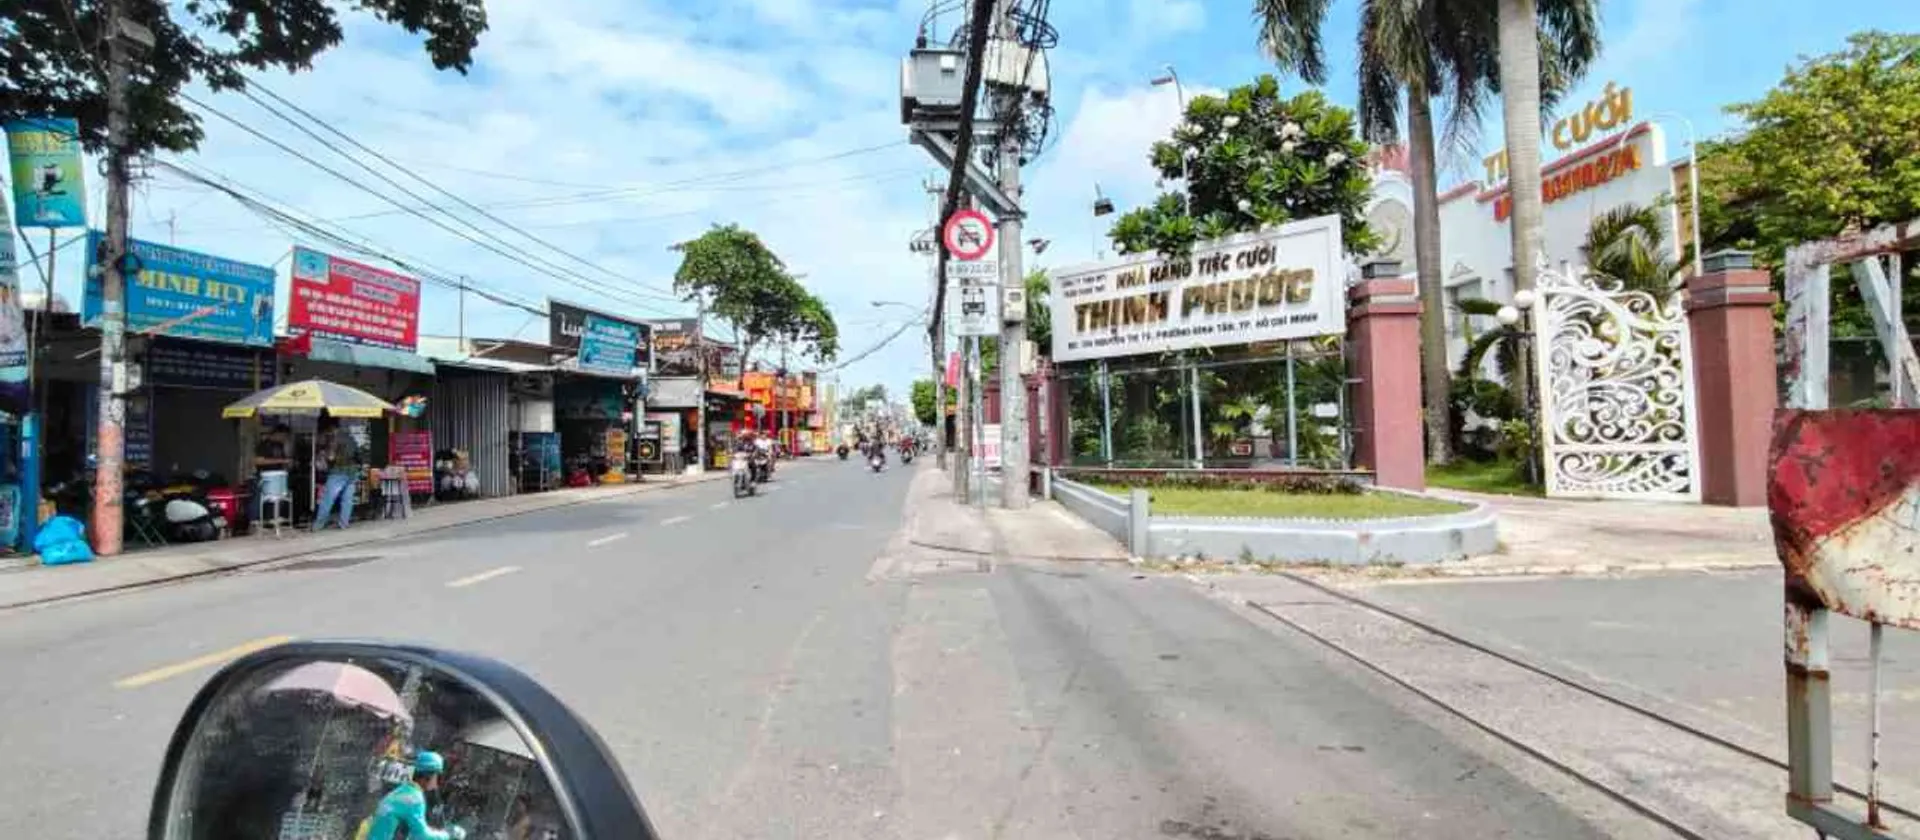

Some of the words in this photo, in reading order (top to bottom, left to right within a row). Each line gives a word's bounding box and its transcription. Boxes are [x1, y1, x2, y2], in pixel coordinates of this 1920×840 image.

[137, 268, 200, 296] MINH
[204, 278, 248, 304] HUY
[1116, 263, 1146, 289] NHÀ
[1149, 257, 1192, 283] HÀNG
[1198, 252, 1232, 277] TIỆC
[1236, 241, 1277, 270] CƯỚI
[1074, 289, 1169, 335] THỊNH
[1180, 265, 1314, 318] PHƯỚC
